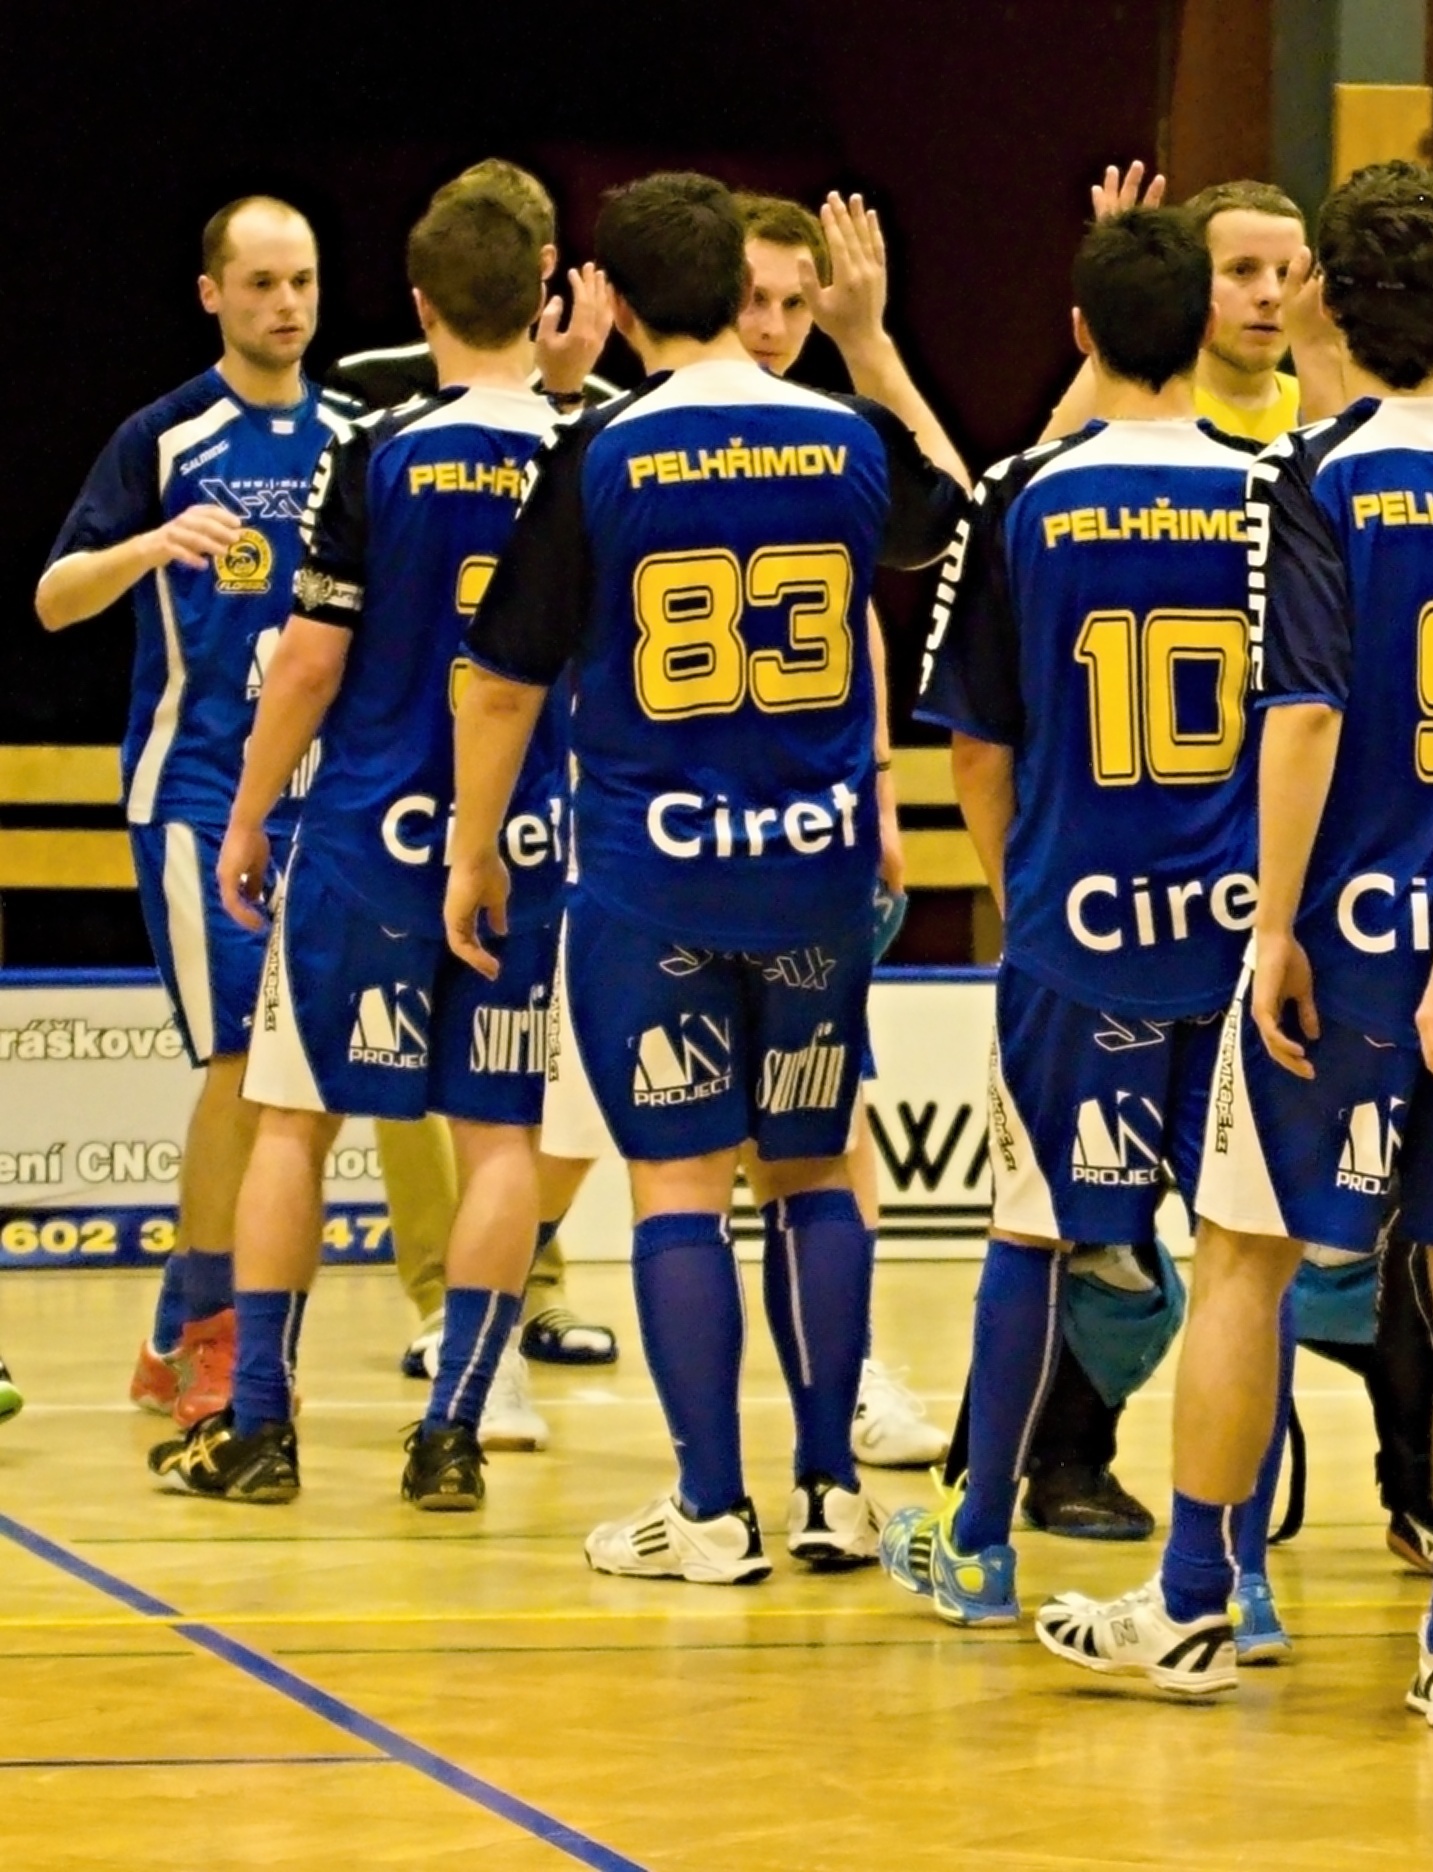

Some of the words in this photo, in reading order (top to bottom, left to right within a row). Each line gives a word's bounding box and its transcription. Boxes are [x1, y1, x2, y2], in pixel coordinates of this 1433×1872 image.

[409, 458, 522, 499] PELHŘ
[628, 437, 847, 488] PELHŘIMOV
[1043, 497, 1248, 548] PELHŘIMO
[633, 543, 854, 721] 83
[1074, 610, 1248, 786] 10
[647, 782, 859, 859] Ciret
[1067, 872, 1258, 952] Cire
[349, 1048, 428, 1069] PROJEC
[634, 1075, 732, 1107] PROJECT
[76, 1140, 183, 1183] CNC
[1072, 1167, 1159, 1187] PROJEC
[1, 1219, 118, 1254] 602
